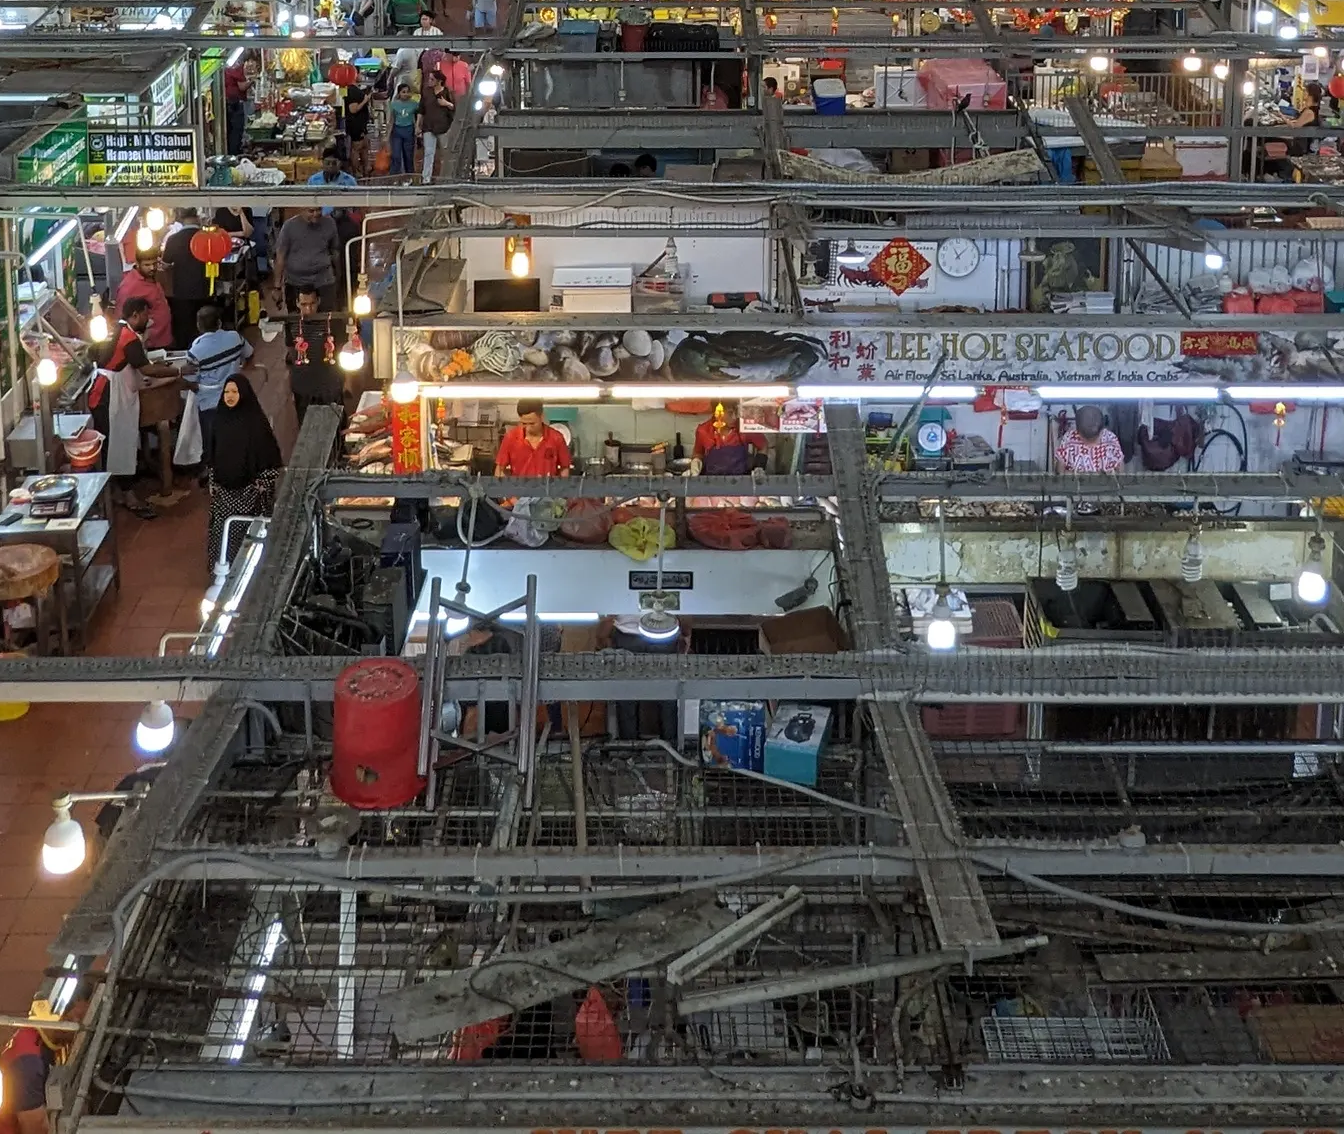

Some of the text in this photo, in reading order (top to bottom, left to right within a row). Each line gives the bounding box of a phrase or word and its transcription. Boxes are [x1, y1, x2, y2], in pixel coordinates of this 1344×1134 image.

[154, 133, 192, 147] Shahul
[106, 149, 145, 161] Hameed
[145, 148, 192, 162] Marketing
[147, 165, 180, 174] QUALITY
[885, 246, 913, 275] 福
[828, 330, 852, 371] 利和
[884, 332, 1176, 362] LEE HOE SEAFOOD
[884, 370, 904, 380] Air
[940, 370, 956, 381] Sri
[958, 370, 996, 383] Lanka,
[998, 370, 1052, 383] Australia,
[1057, 370, 1104, 381] Vietnam
[1105, 370, 1115, 381] &
[1118, 370, 1144, 381] India
[1146, 370, 1180, 381] Crabs
